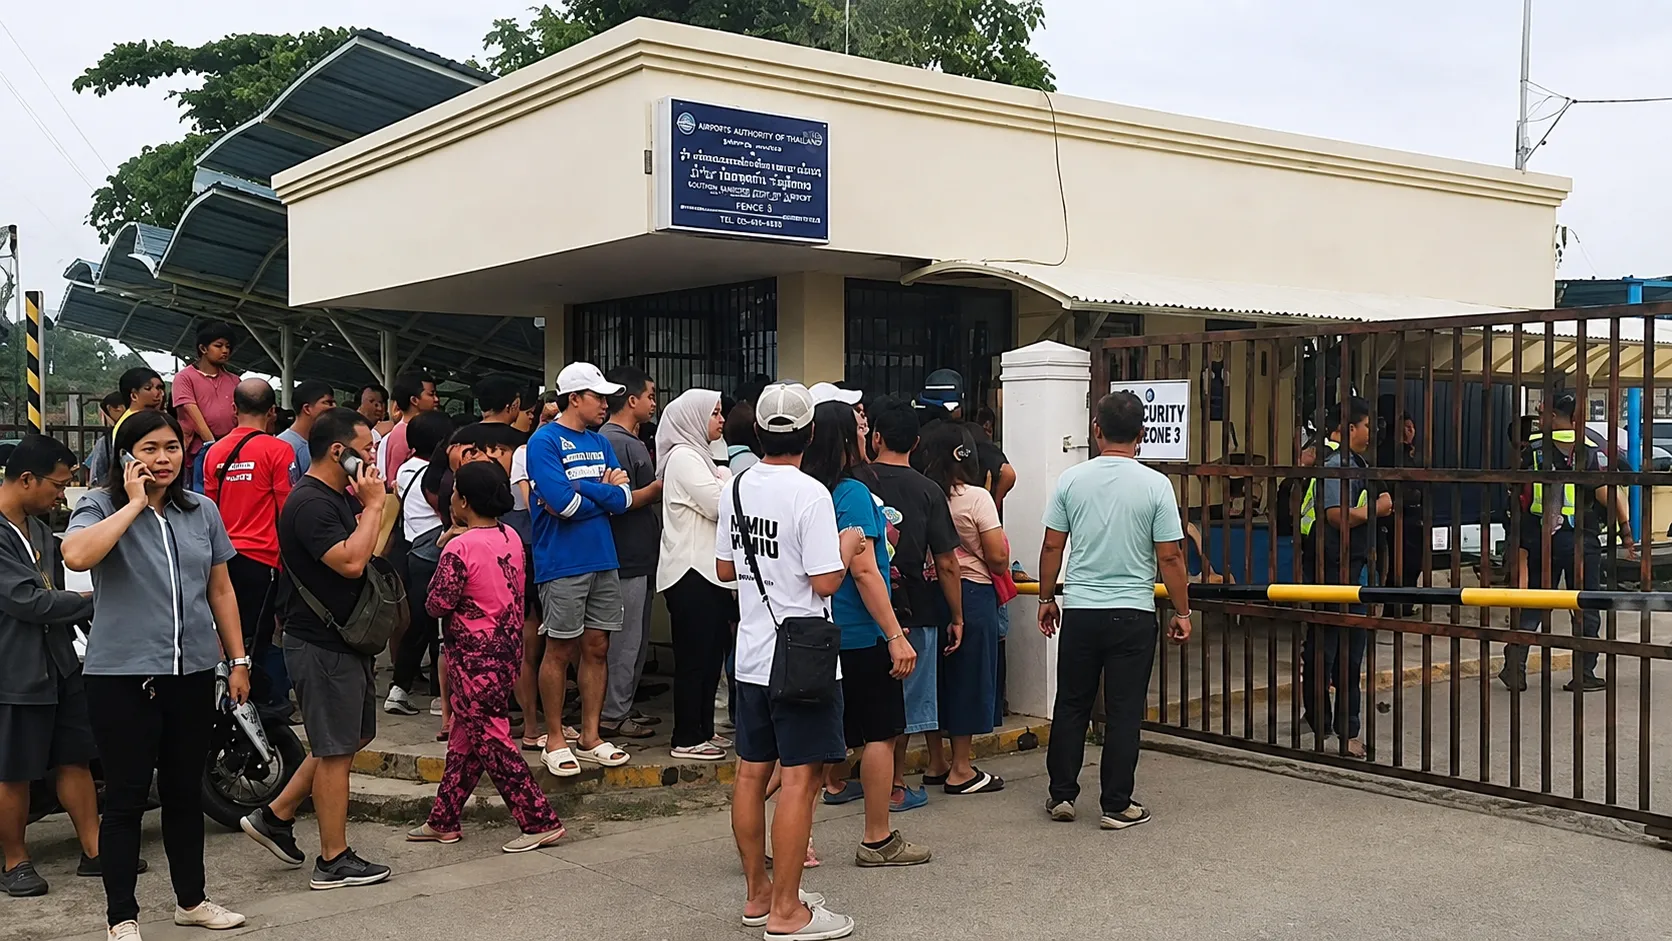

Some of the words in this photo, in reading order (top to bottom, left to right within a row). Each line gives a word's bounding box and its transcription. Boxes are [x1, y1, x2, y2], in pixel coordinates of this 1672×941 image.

[733, 128, 774, 140] AUTHORITY
[774, 134, 785, 142] OF
[736, 202, 764, 213] FENCE
[1143, 404, 1186, 423] CURITY
[1173, 426, 1181, 444] 3
